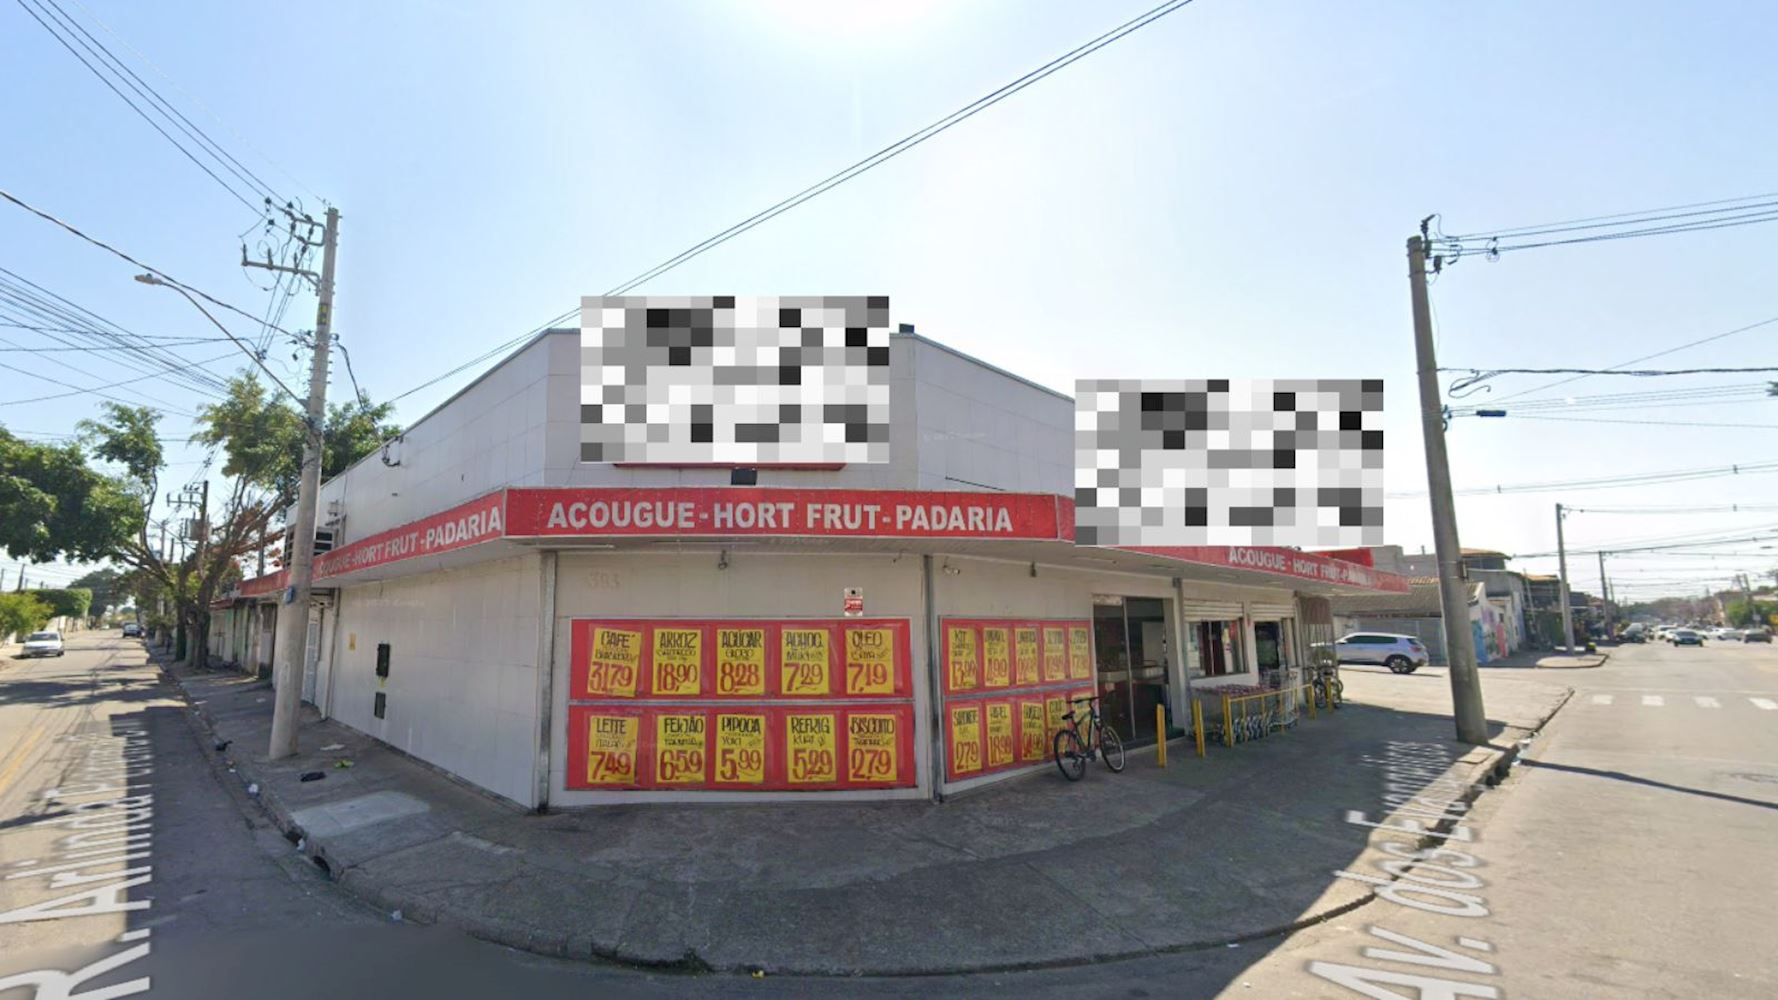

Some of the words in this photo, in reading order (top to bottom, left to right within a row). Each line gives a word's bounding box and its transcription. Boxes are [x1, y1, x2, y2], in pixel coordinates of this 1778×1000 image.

[384, 531, 418, 559] FRUT
[426, 506, 501, 550] PADARIA
[714, 502, 794, 529] HORT
[807, 503, 881, 530] FRUT
[896, 504, 1013, 532] PADARIA
